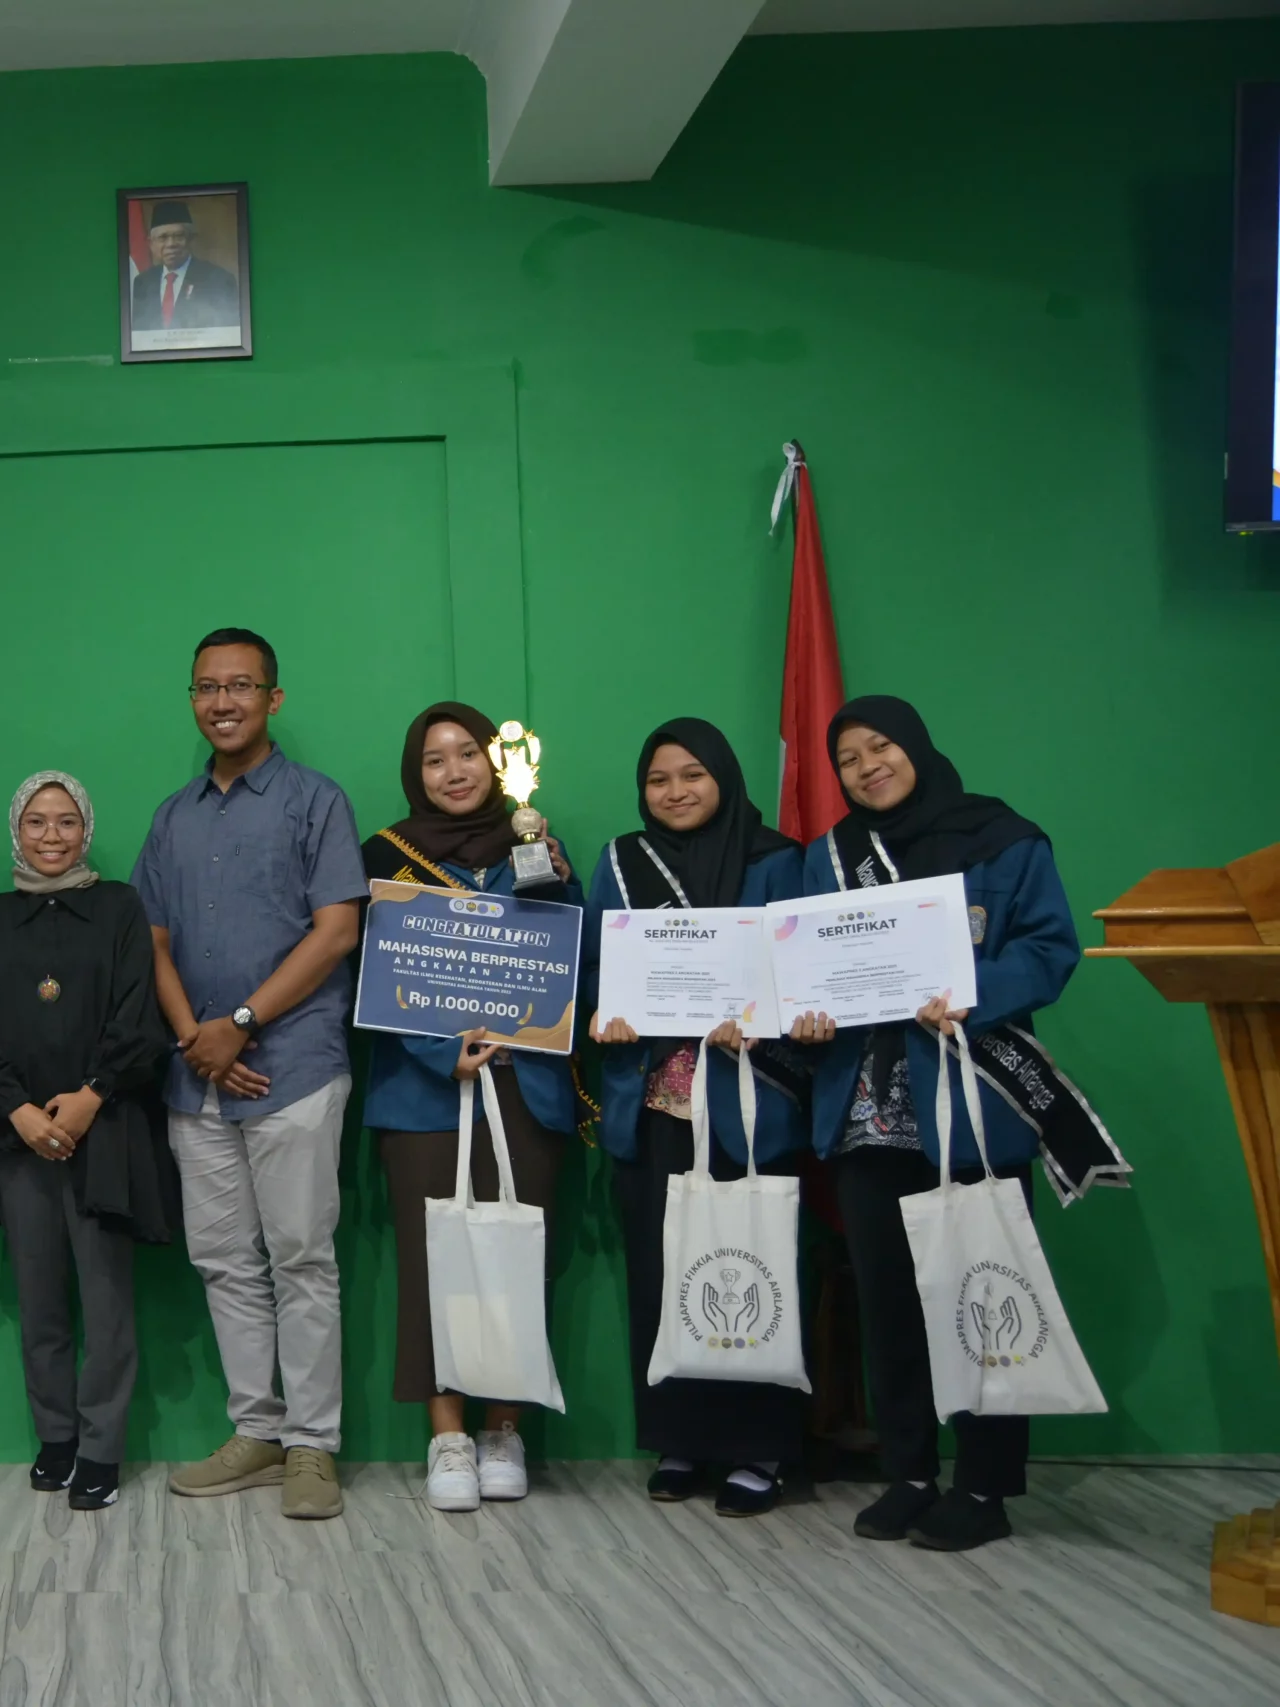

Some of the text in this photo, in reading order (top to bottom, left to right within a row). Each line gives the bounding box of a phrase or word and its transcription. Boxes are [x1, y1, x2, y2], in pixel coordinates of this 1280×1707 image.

[402, 915, 550, 948] CONGRATULATION
[644, 929, 718, 939] SERTIFIKAT
[817, 918, 898, 938] SERTIFIKAT
[378, 940, 569, 975] MAHASISWA BERPRESTASI
[394, 957, 545, 983] ANGKATAN 2021
[409, 991, 519, 1018] Rp 1.000.000
[1014, 1059, 1055, 1111] Airlangga
[680, 1248, 783, 1342] PILMAPRES FIKKIA UNIVERSITAS AIRLANGGA
[1028, 1293, 1049, 1359] AIRLANGGA
